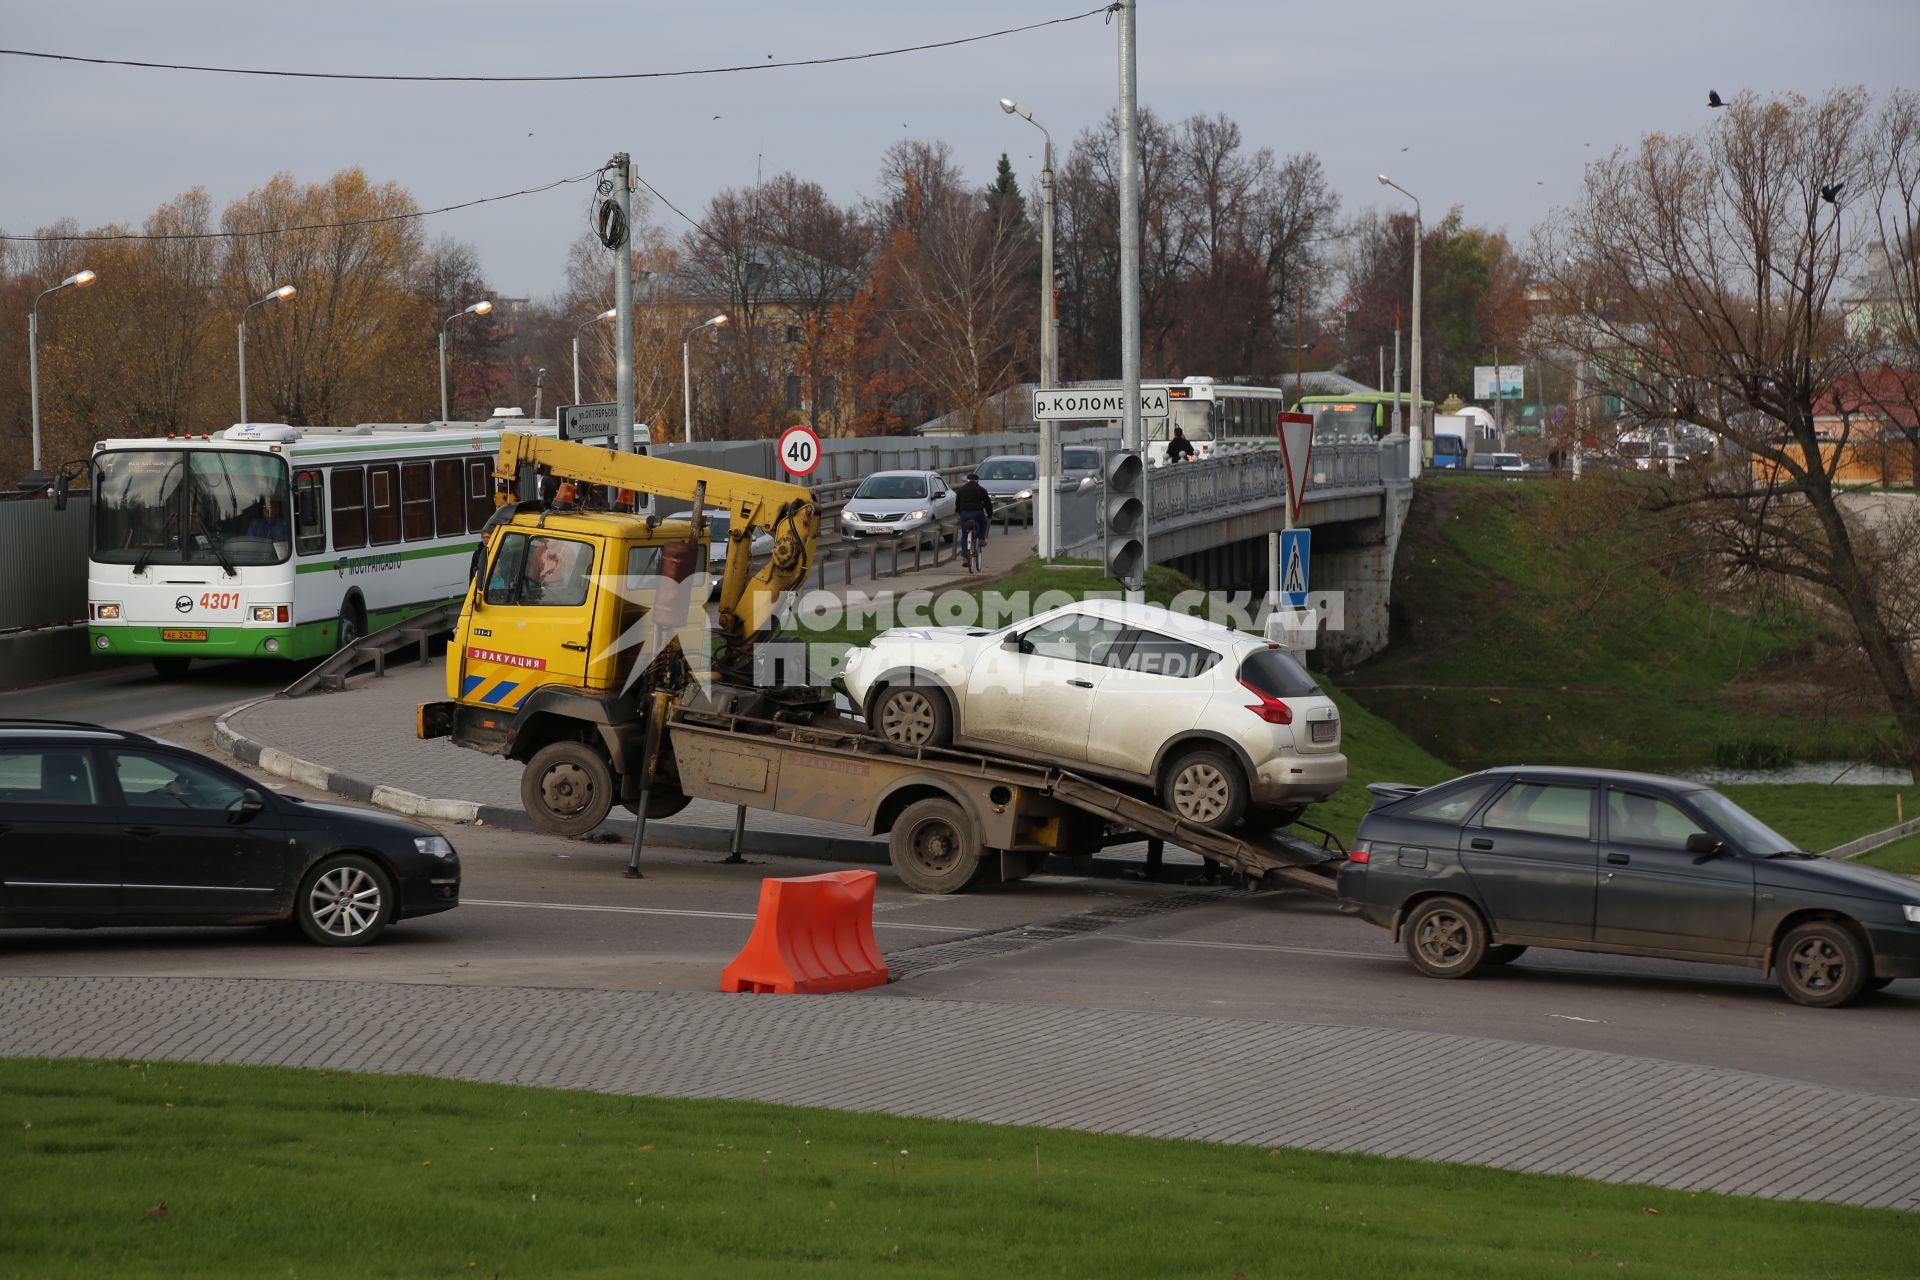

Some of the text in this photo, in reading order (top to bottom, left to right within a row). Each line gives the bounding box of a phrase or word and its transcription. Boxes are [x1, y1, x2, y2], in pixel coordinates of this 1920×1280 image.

[579, 407, 617, 420] ул.ОКТЯБРЬСКО
[1037, 396, 1164, 414] р.КОЛОМЕКА
[579, 422, 610, 434] РЕВОЛЮЦИИ
[788, 441, 811, 462] 40
[349, 552, 401, 575] МОСТРАНСАВТО
[200, 593, 239, 609] 4301
[179, 631, 193, 639] 242
[475, 649, 539, 668] ЭВАКУАЦИЯ
